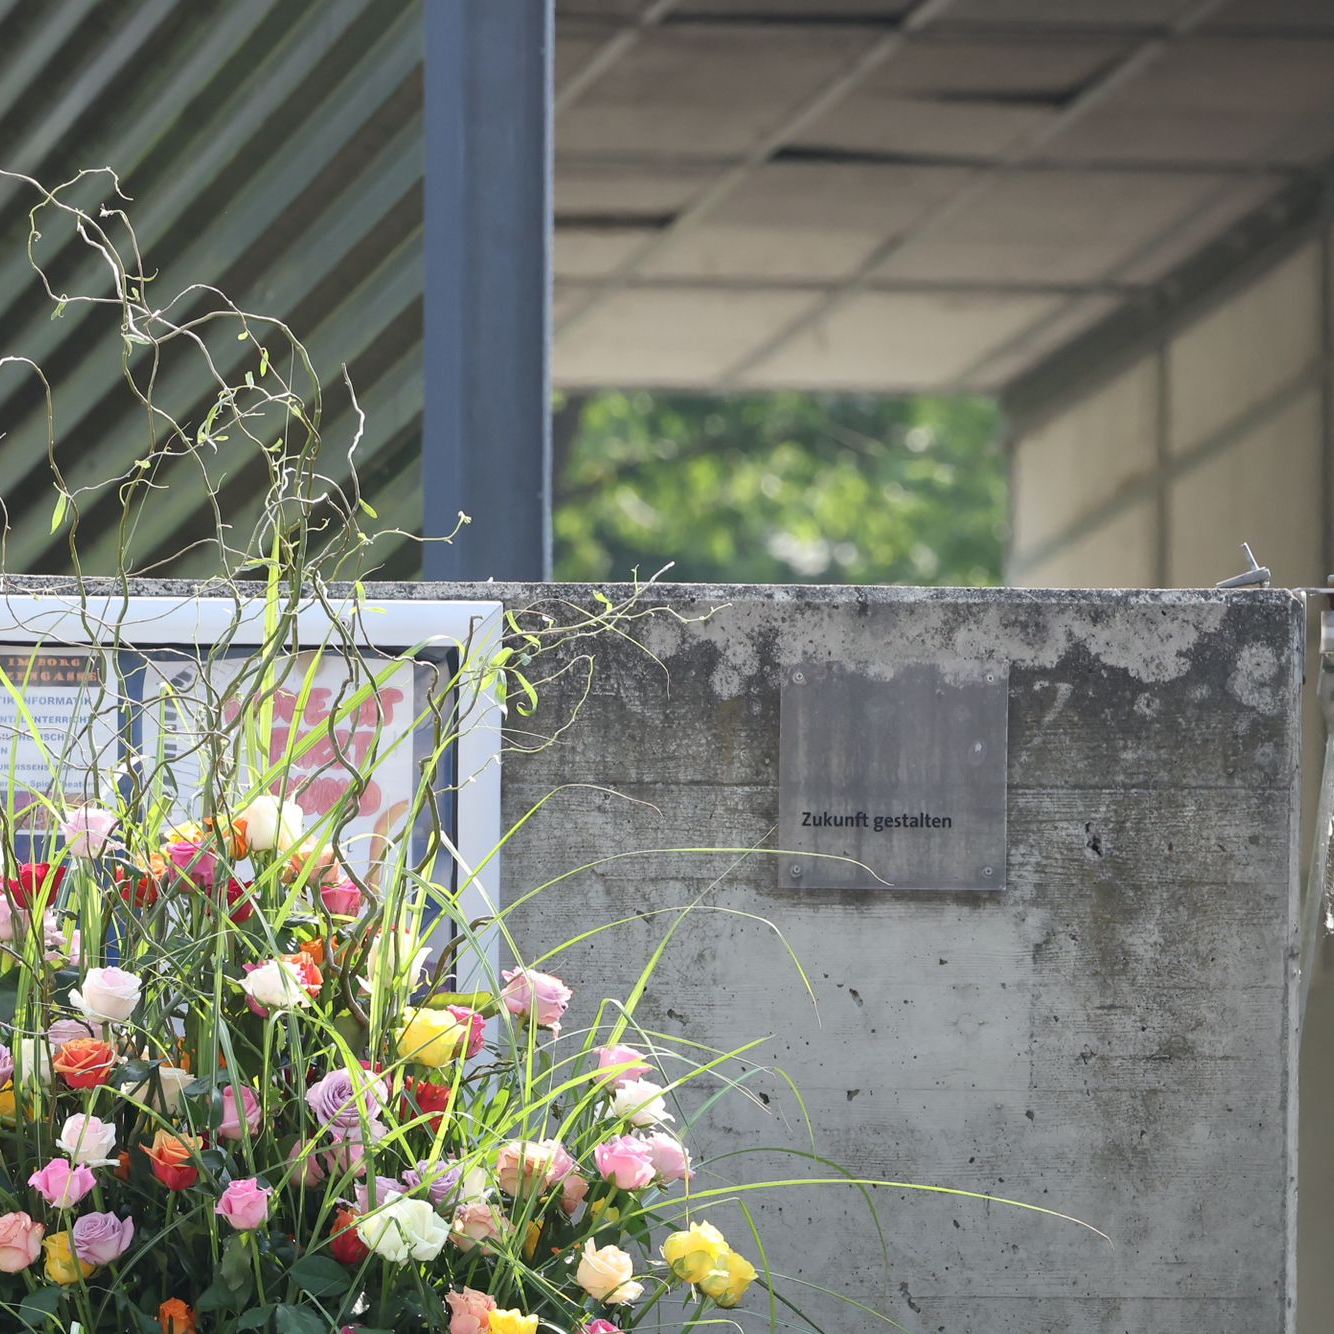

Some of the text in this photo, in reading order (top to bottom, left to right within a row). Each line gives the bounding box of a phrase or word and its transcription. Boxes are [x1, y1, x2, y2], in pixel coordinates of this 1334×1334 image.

[18, 696, 92, 706] NFORMATIK
[801, 811, 952, 832] Zukunft gestalten
